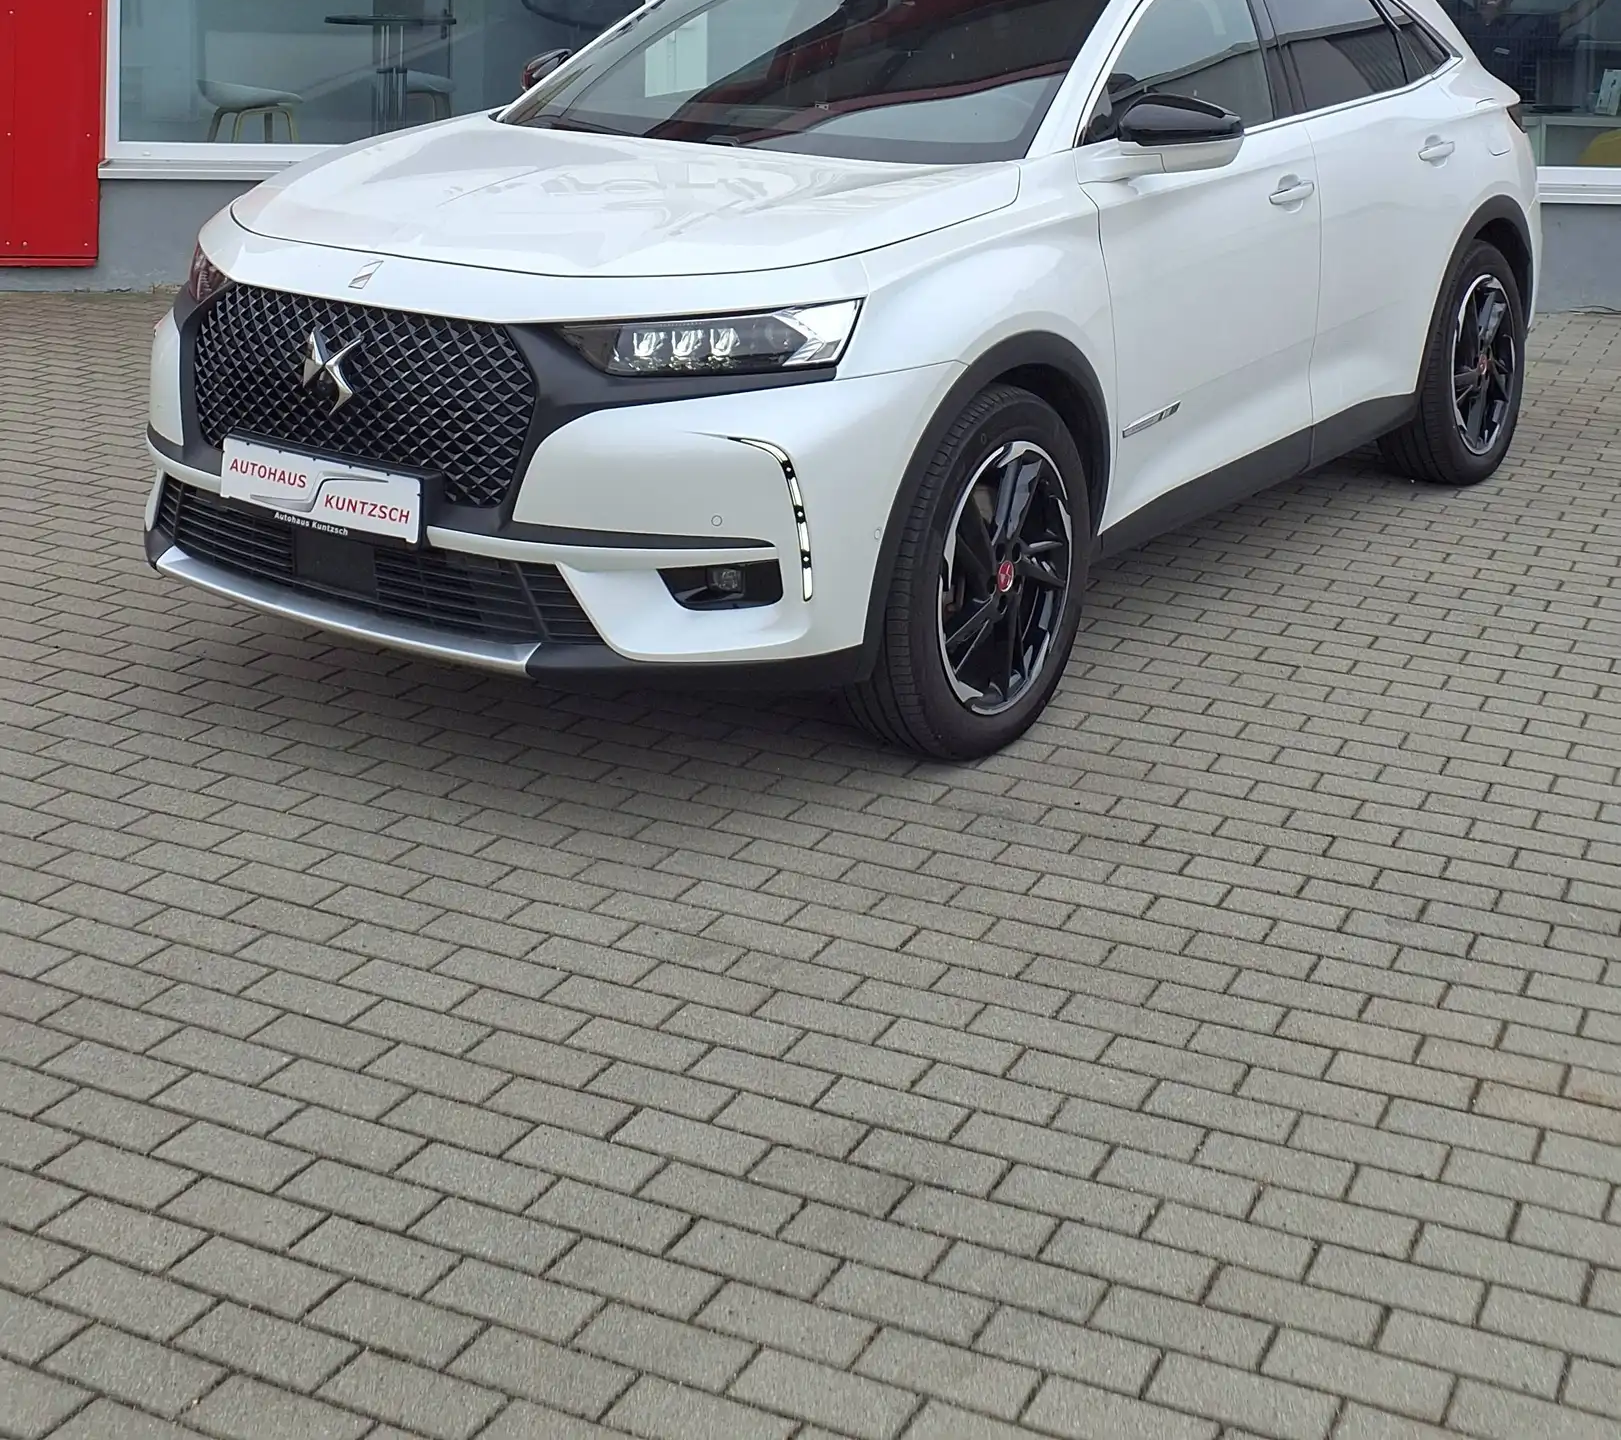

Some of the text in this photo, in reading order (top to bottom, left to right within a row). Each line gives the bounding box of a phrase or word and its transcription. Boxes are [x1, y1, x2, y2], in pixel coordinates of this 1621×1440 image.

[229, 458, 308, 489] AUTOHAUS
[274, 511, 349, 536] Autohaus Kuntzsch
[324, 493, 410, 524] KUNTZSCH
